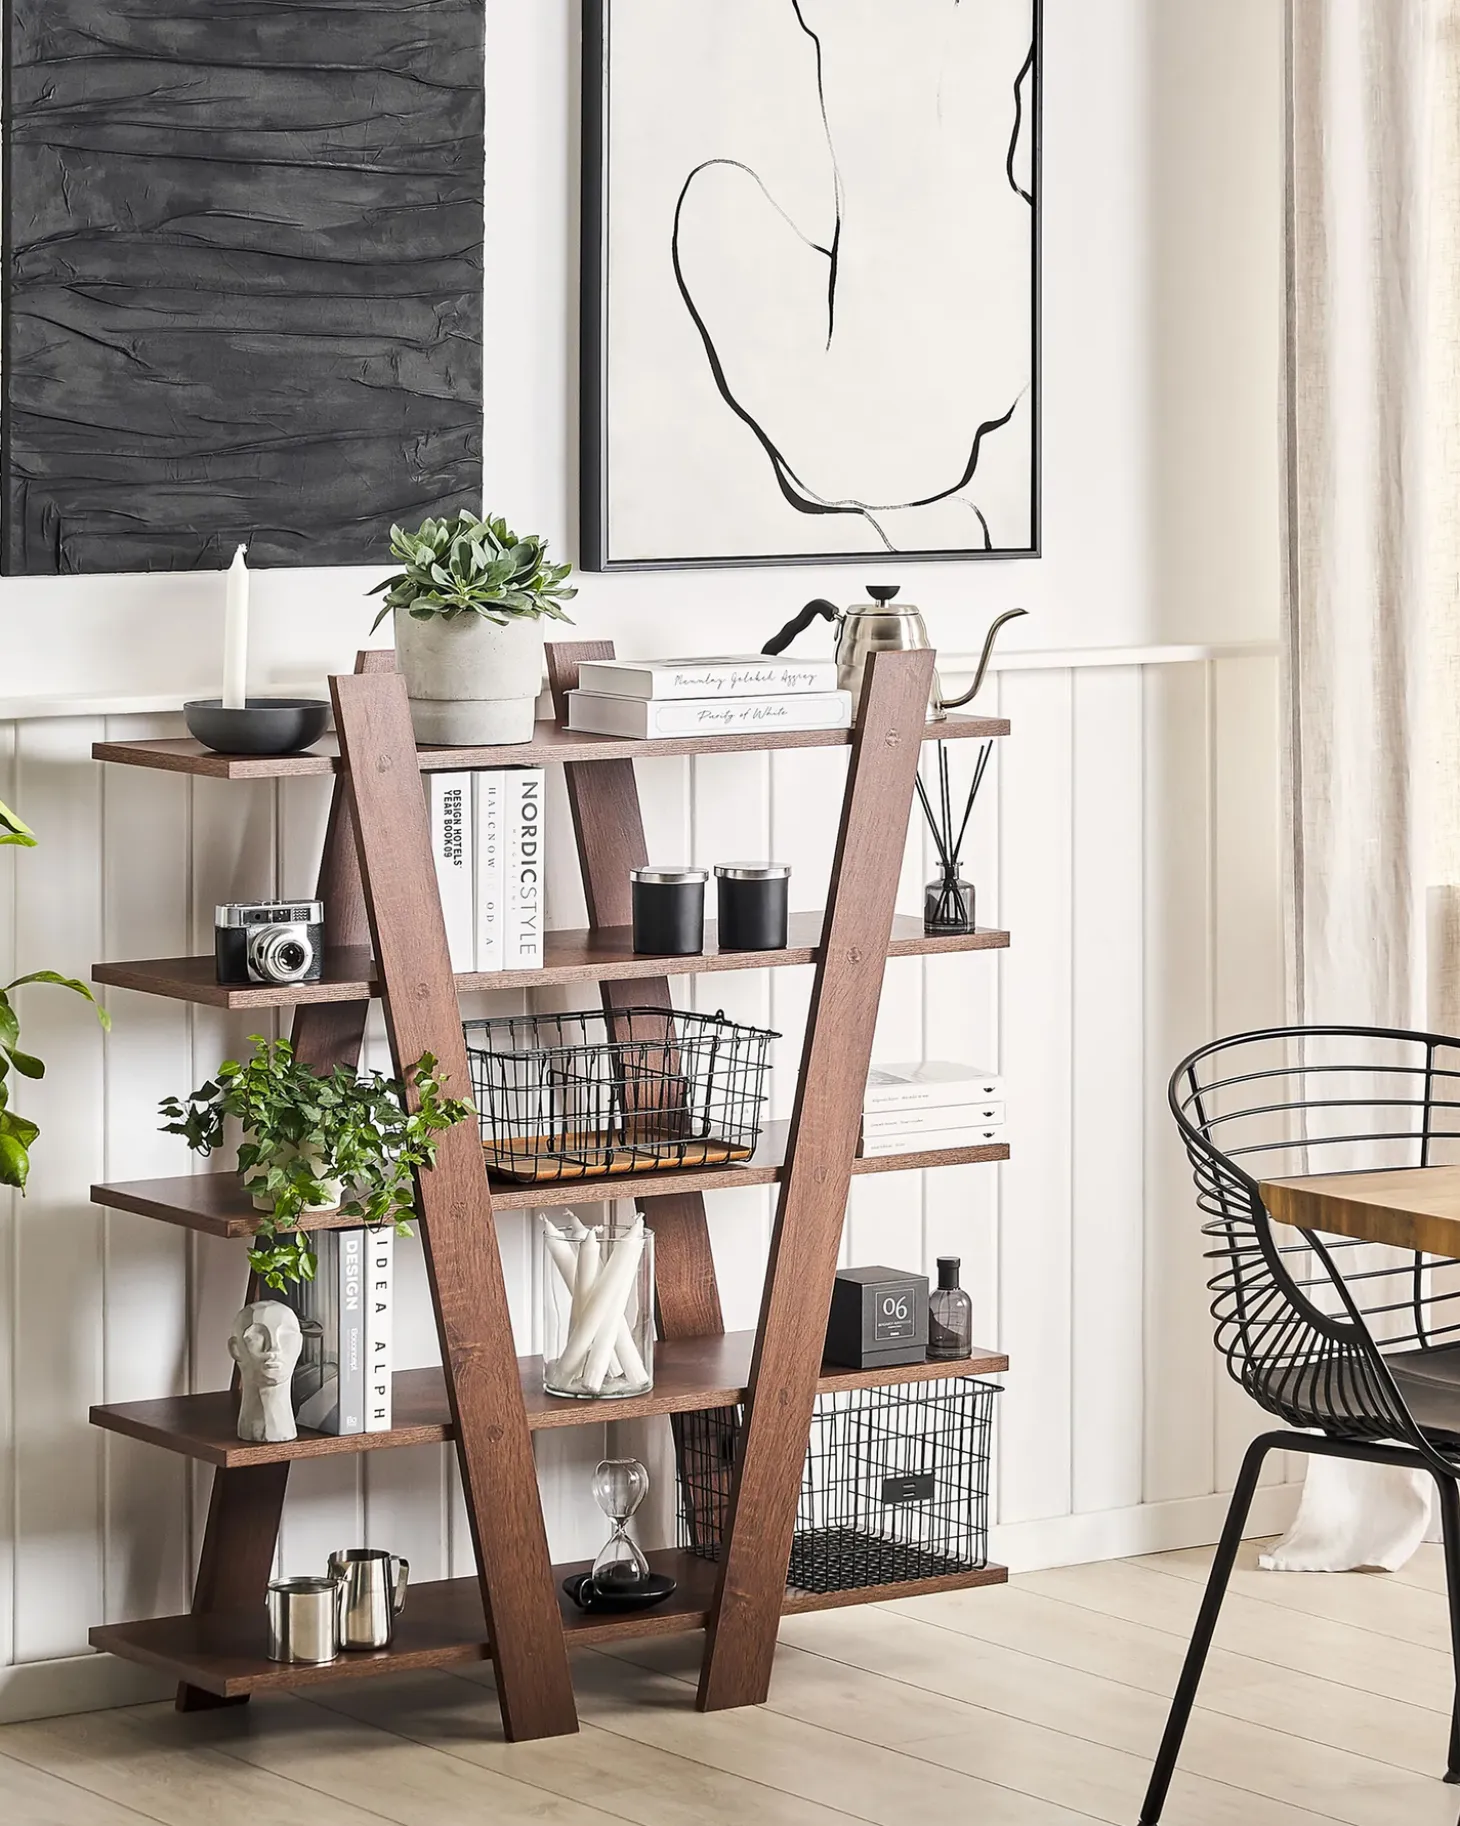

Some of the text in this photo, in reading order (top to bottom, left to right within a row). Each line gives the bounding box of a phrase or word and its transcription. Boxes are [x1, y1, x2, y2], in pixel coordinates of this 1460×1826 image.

[697, 706, 789, 725] Purity of White
[443, 789, 453, 816] YEAR
[453, 789, 462, 825] DESIGN
[345, 1240, 358, 1312] DESIGN
[882, 1295, 908, 1320] 06
[373, 1241, 388, 1419] IDEA ALPH
